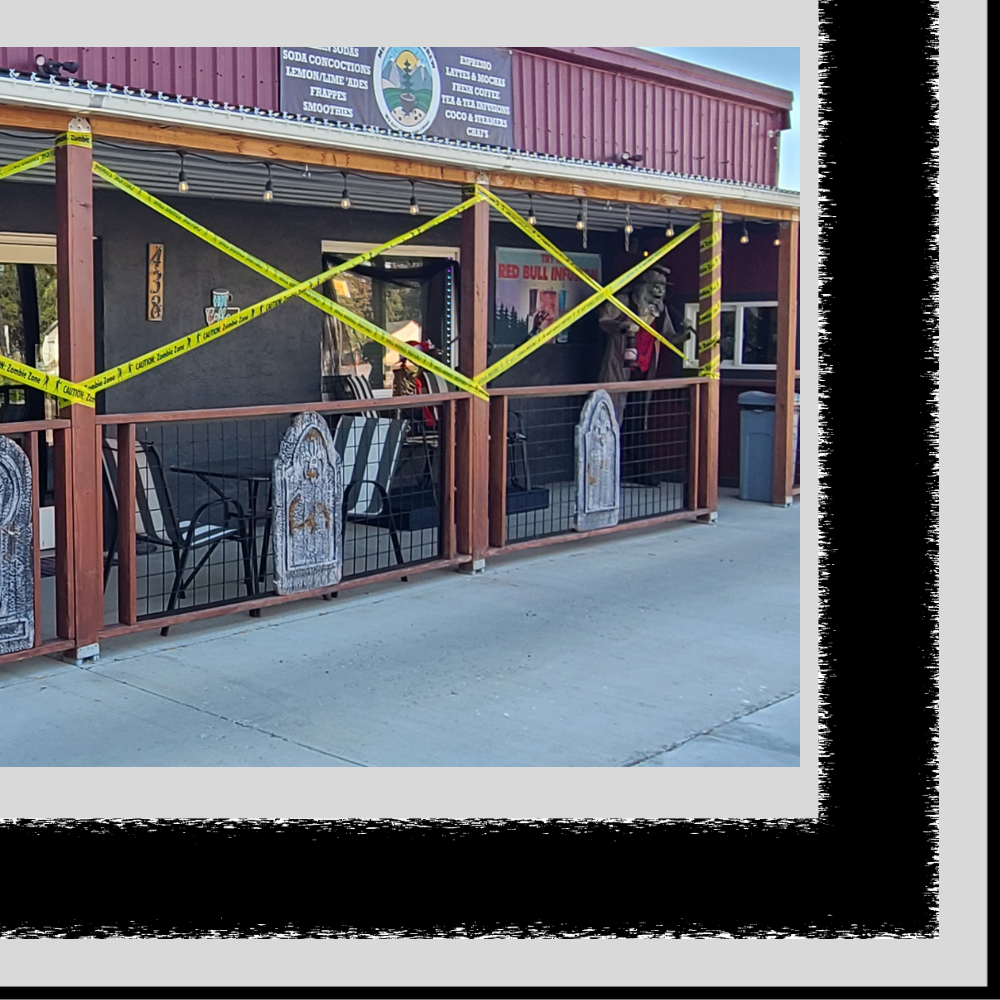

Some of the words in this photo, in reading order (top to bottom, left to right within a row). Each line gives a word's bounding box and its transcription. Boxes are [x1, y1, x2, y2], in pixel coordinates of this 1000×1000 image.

[283, 50, 308, 63] SODA
[308, 54, 371, 75] CONCOCTIONS
[460, 56, 492, 70] ESPRESSO
[286, 66, 345, 86] LEMON/LIME
[346, 77, 368, 90] 'ADES
[446, 67, 470, 80] LATTES
[471, 72, 476, 81] &
[478, 73, 506, 87] MOCHAS
[310, 86, 347, 101] FRAPPES
[452, 82, 473, 95] FRESH
[474, 87, 501, 99] COFFEE
[303, 101, 353, 118] SMOOTHIES
[441, 95, 455, 105] TEA
[456, 98, 462, 107] &
[462, 98, 476, 109] TEA
[476, 101, 510, 115] INFUSIONS
[445, 110, 467, 121] COCO
[468, 113, 473, 122] &
[474, 114, 508, 128] STEAMERS
[498, 263, 519, 279] RED
[523, 265, 548, 280] BULL
[150, 247, 162, 318] 438
[156, 349, 173, 362] Zombie
[174, 344, 185, 354] Zone
[7, 364, 26, 379] Zombie
[27, 372, 41, 384] Zone
[104, 374, 115, 385] Zone
[63, 385, 85, 401] CAUTION:
